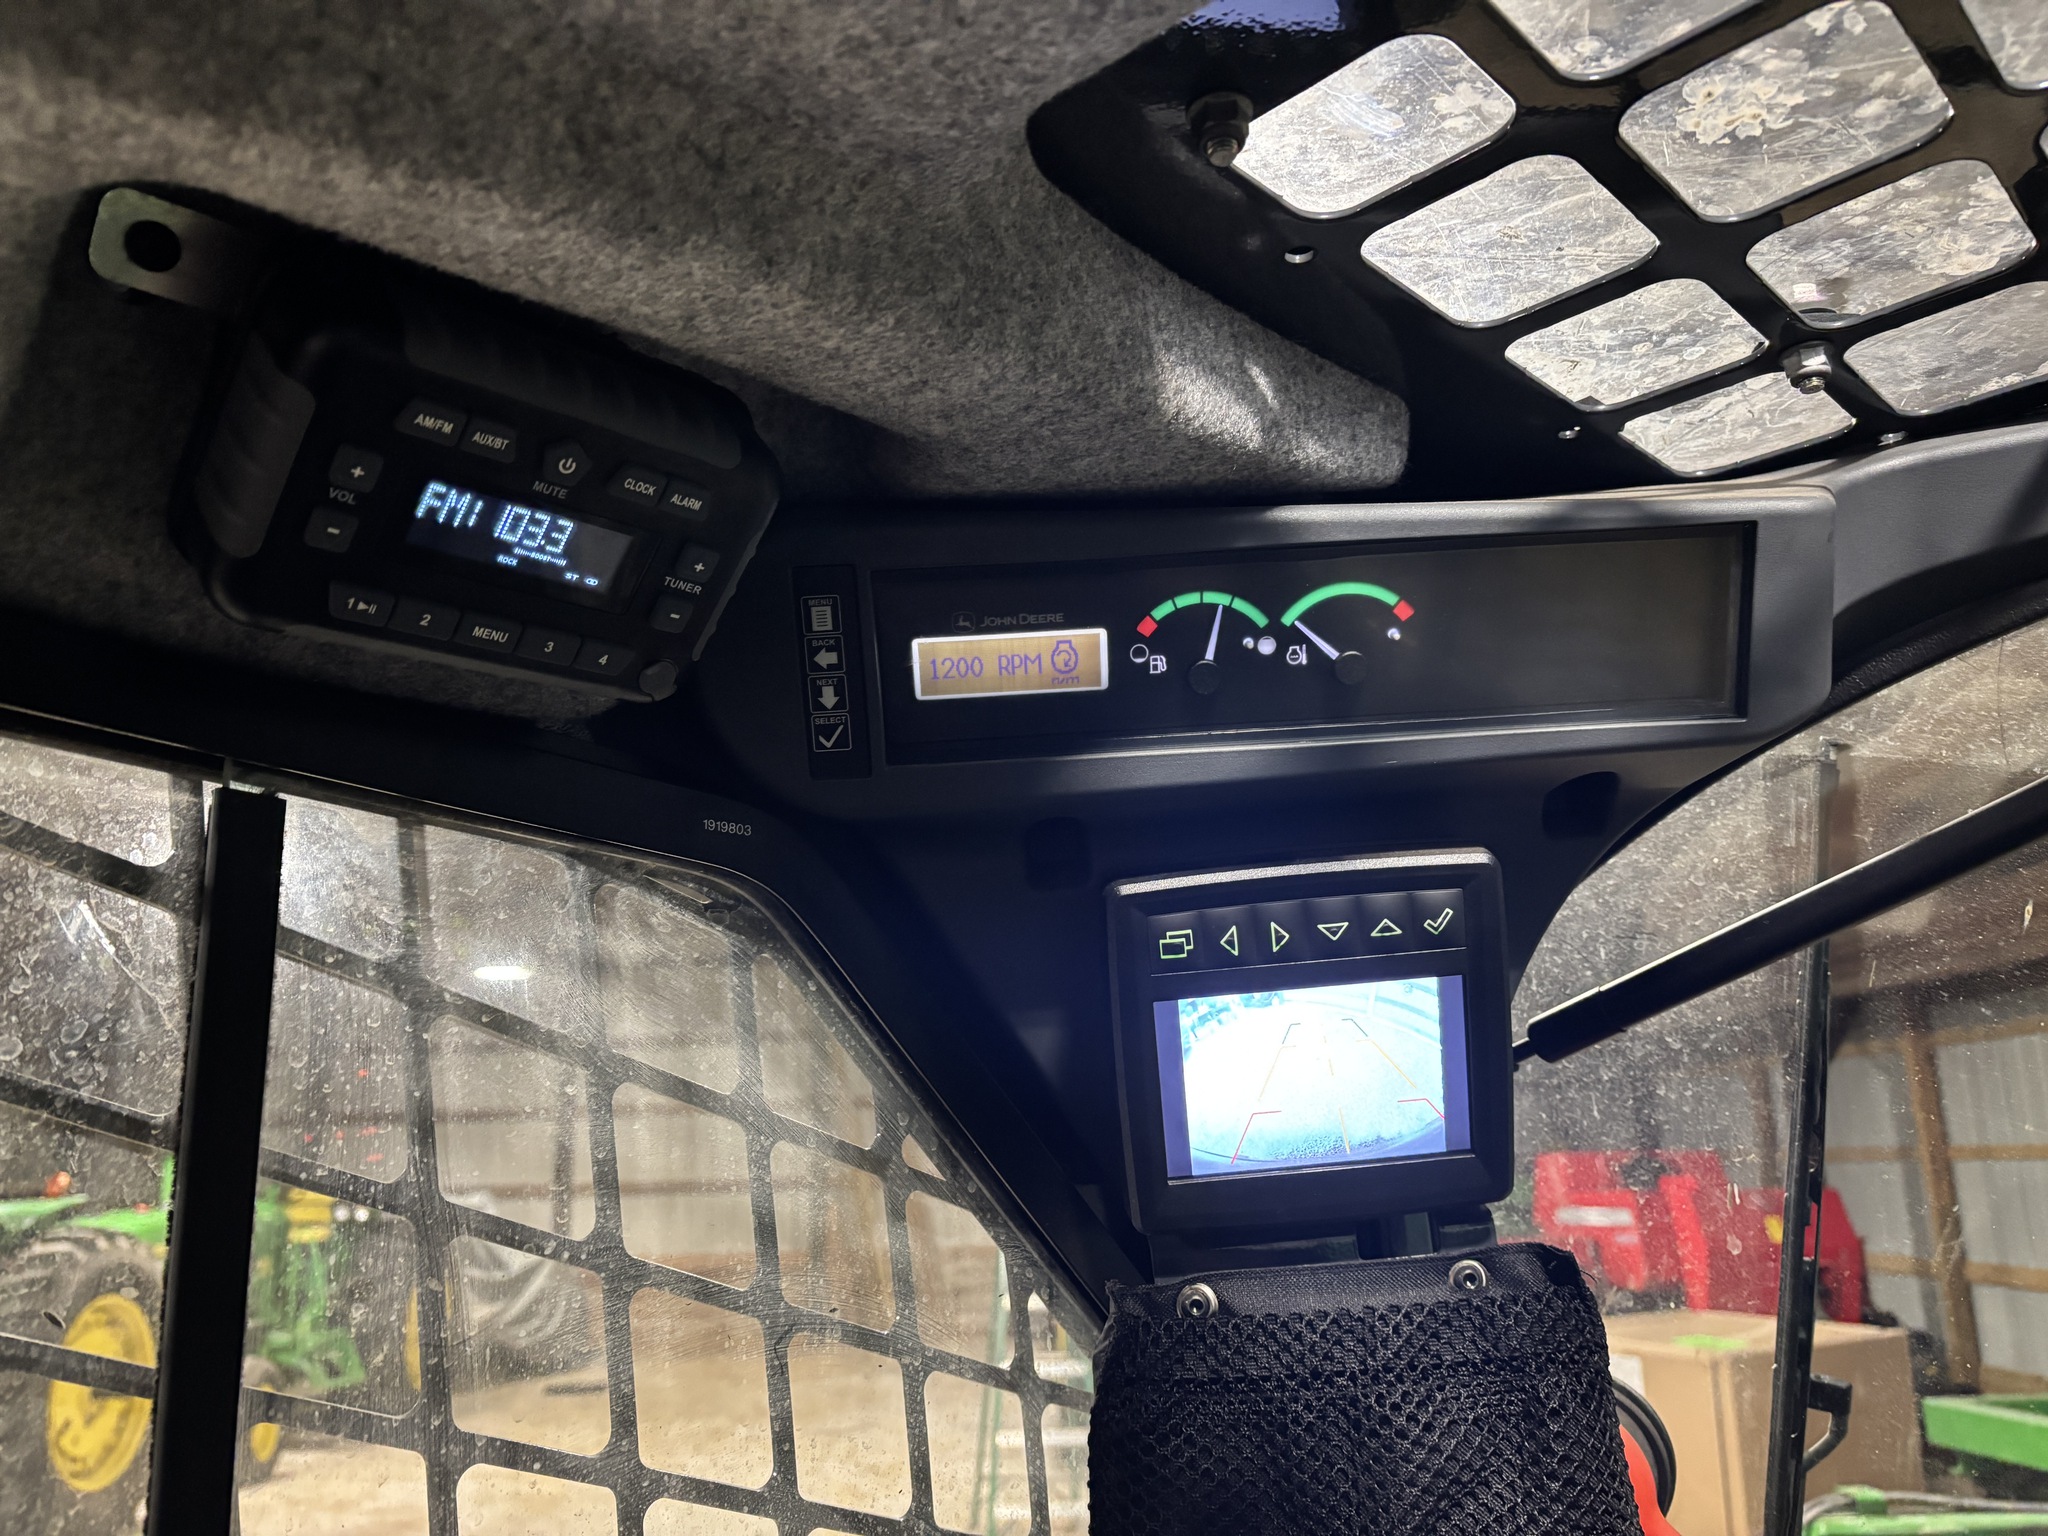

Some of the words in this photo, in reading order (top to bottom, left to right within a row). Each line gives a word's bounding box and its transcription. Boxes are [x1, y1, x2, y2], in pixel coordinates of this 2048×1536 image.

[413, 413, 454, 435] AM/FM
[471, 431, 510, 451] AUX/BT
[532, 480, 570, 499] MUTE
[623, 477, 657, 497] CLOCK
[328, 486, 357, 506] VOL
[669, 493, 703, 512] ALARM
[497, 554, 519, 567] ROCK
[565, 572, 580, 582] ST
[664, 576, 703, 595] TUNER
[346, 597, 357, 610] 1
[808, 597, 833, 607] MENU
[419, 614, 432, 627] 2
[979, 615, 1017, 628] JOHN
[1018, 612, 1065, 625] DEERE
[471, 625, 510, 644] MENU
[543, 641, 555, 653] 3
[811, 638, 836, 648] BACK
[597, 654, 610, 666] 4
[930, 656, 984, 680] 1200
[998, 653, 1043, 677] RPM
[816, 678, 839, 687] NEXT
[814, 715, 847, 725] SELECT
[702, 819, 752, 837] 1919803
